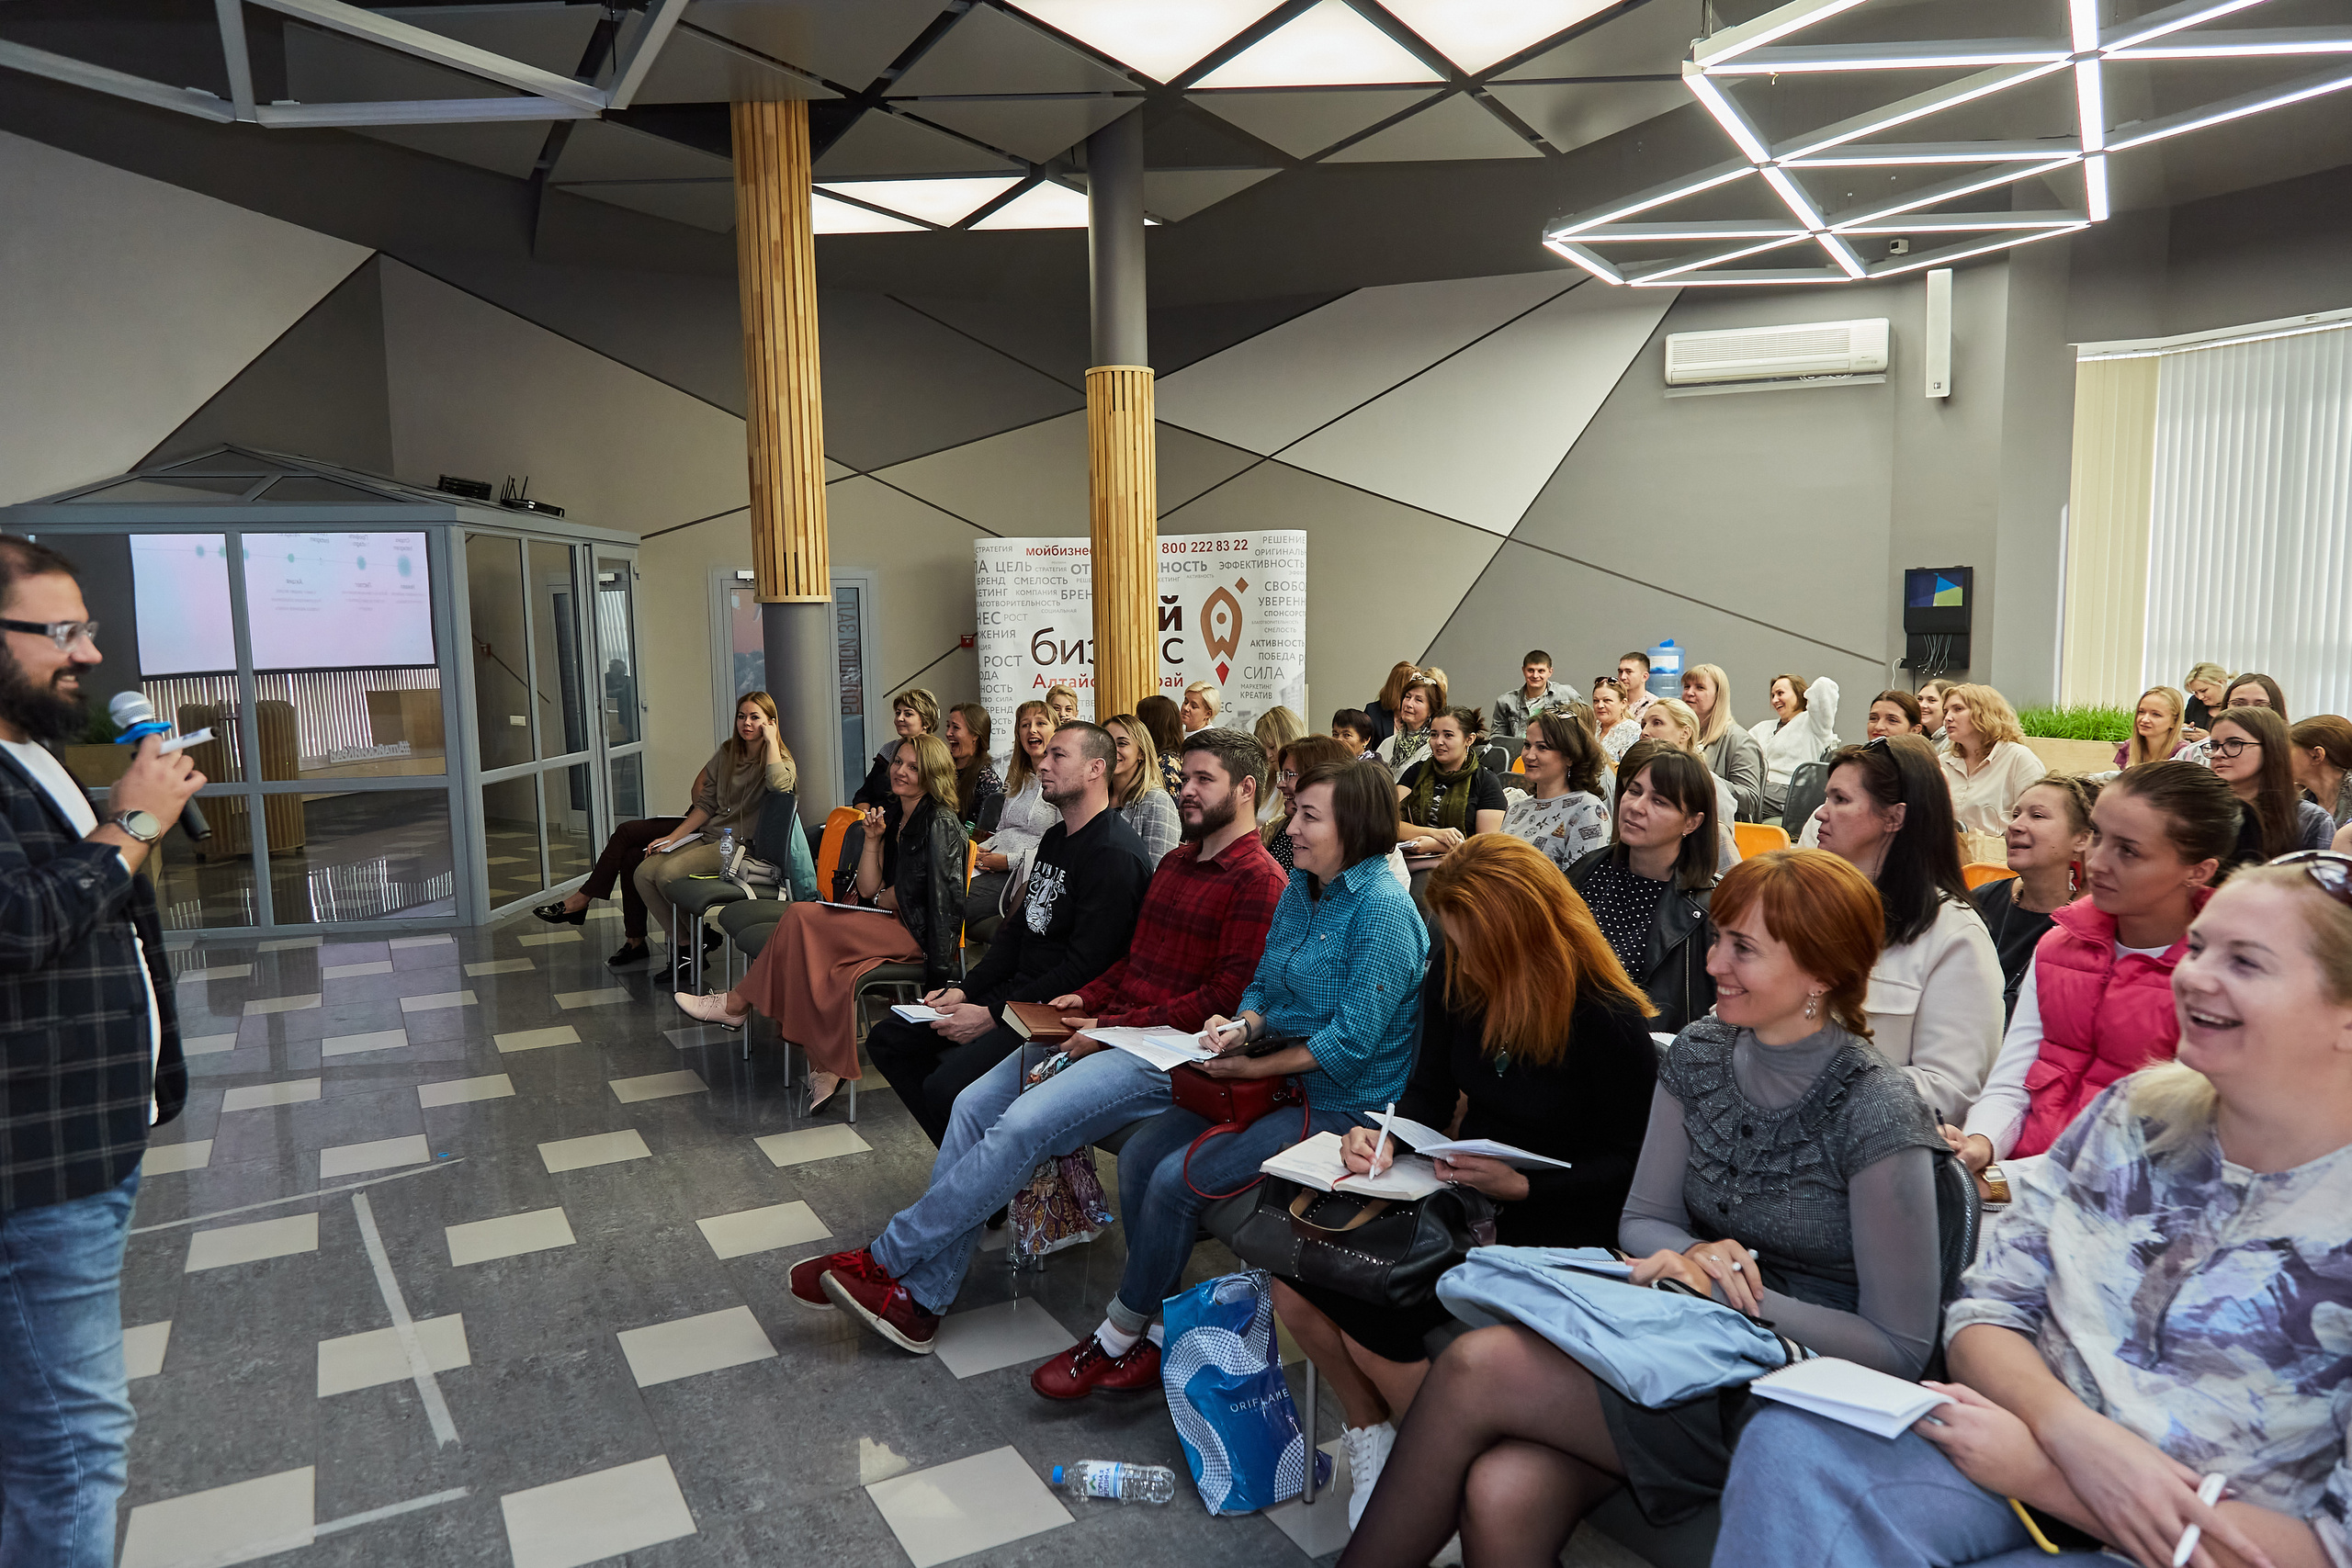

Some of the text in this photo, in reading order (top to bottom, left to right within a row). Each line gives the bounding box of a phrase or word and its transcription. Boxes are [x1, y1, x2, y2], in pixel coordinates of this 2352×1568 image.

[1026, 545, 1091, 556] мойбизне
[1161, 538, 1249, 554] 800 222 83 22
[995, 561, 1033, 574] ЦЕЛЬ
[1158, 560, 1208, 573] НОСТЬ
[1218, 558, 1305, 570] ЭФФЕКТИВНОСТЬ
[977, 576, 1069, 586] БРЕНД СМЕЛОСТЬ
[1003, 614, 1028, 622] РОСТ
[1250, 639, 1305, 648] АКТИВНОСТЬ
[984, 655, 1023, 667] РОСТ
[1258, 651, 1295, 661] ПОБЕДА
[1243, 666, 1285, 680] СИЛА
[1240, 691, 1272, 699] КРЕАТИВ
